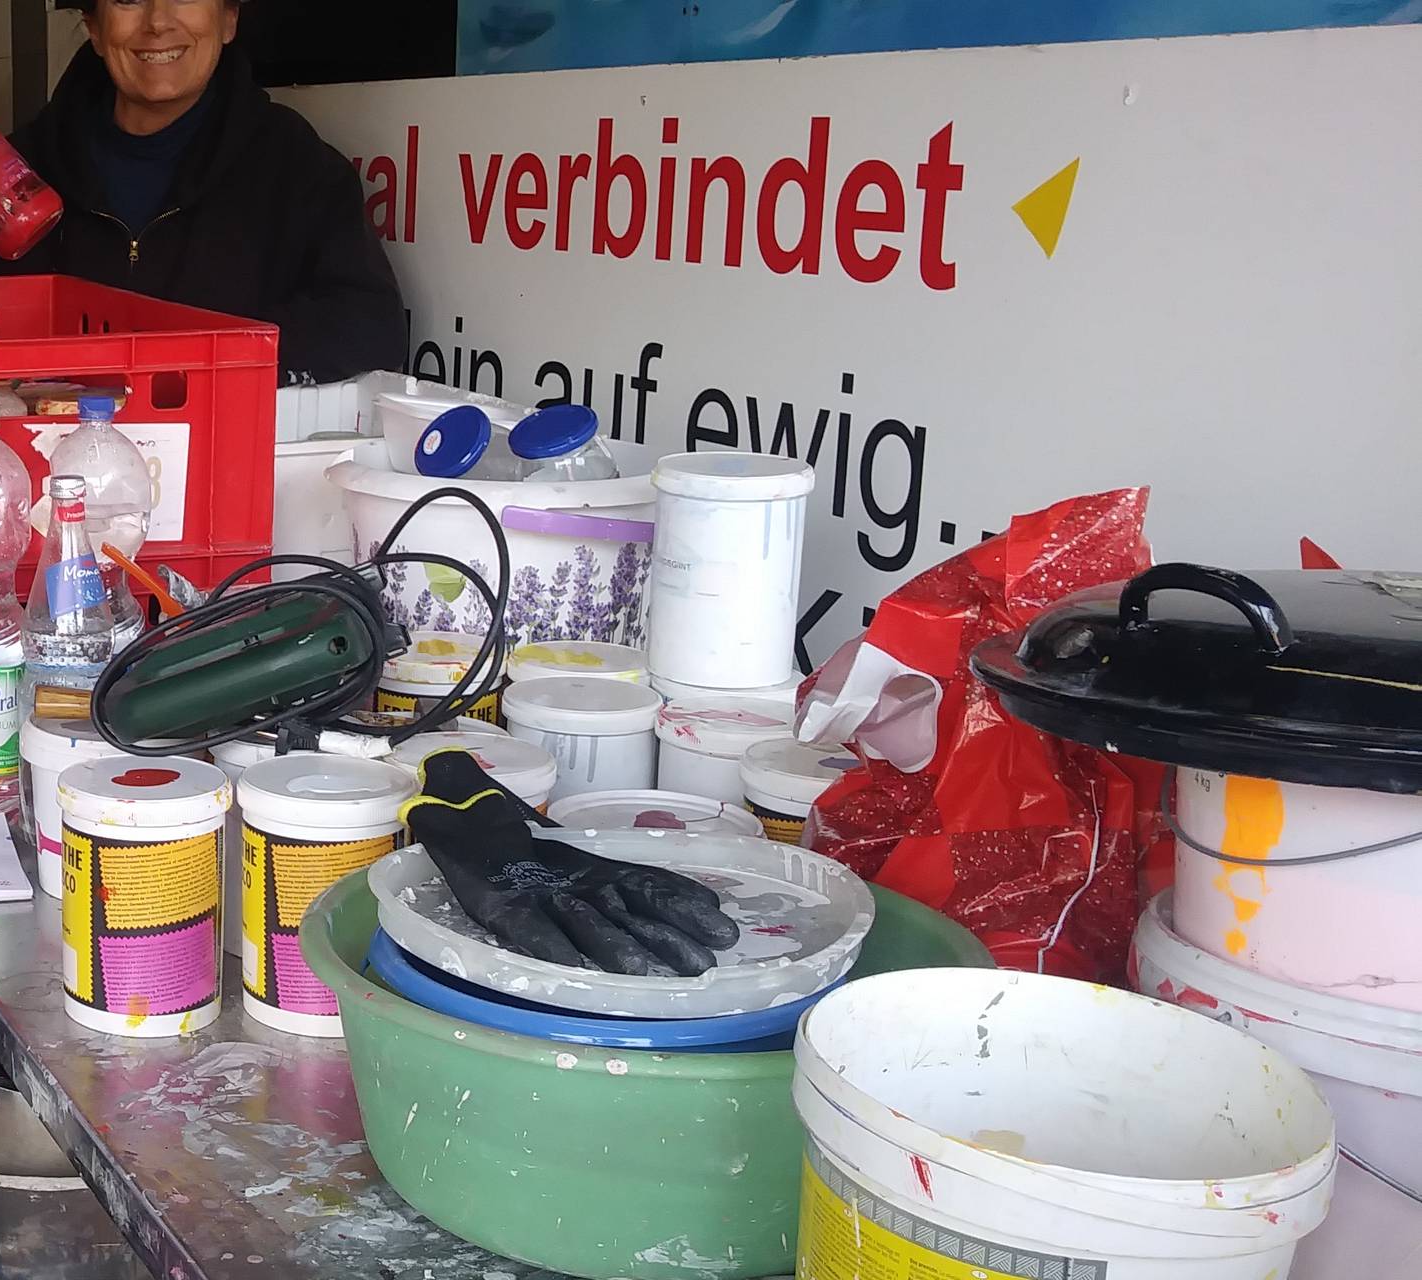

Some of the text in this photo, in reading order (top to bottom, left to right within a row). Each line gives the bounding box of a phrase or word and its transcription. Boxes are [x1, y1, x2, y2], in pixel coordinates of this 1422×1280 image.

[351, 117, 964, 291] al verbindet
[534, 342, 664, 444] auf
